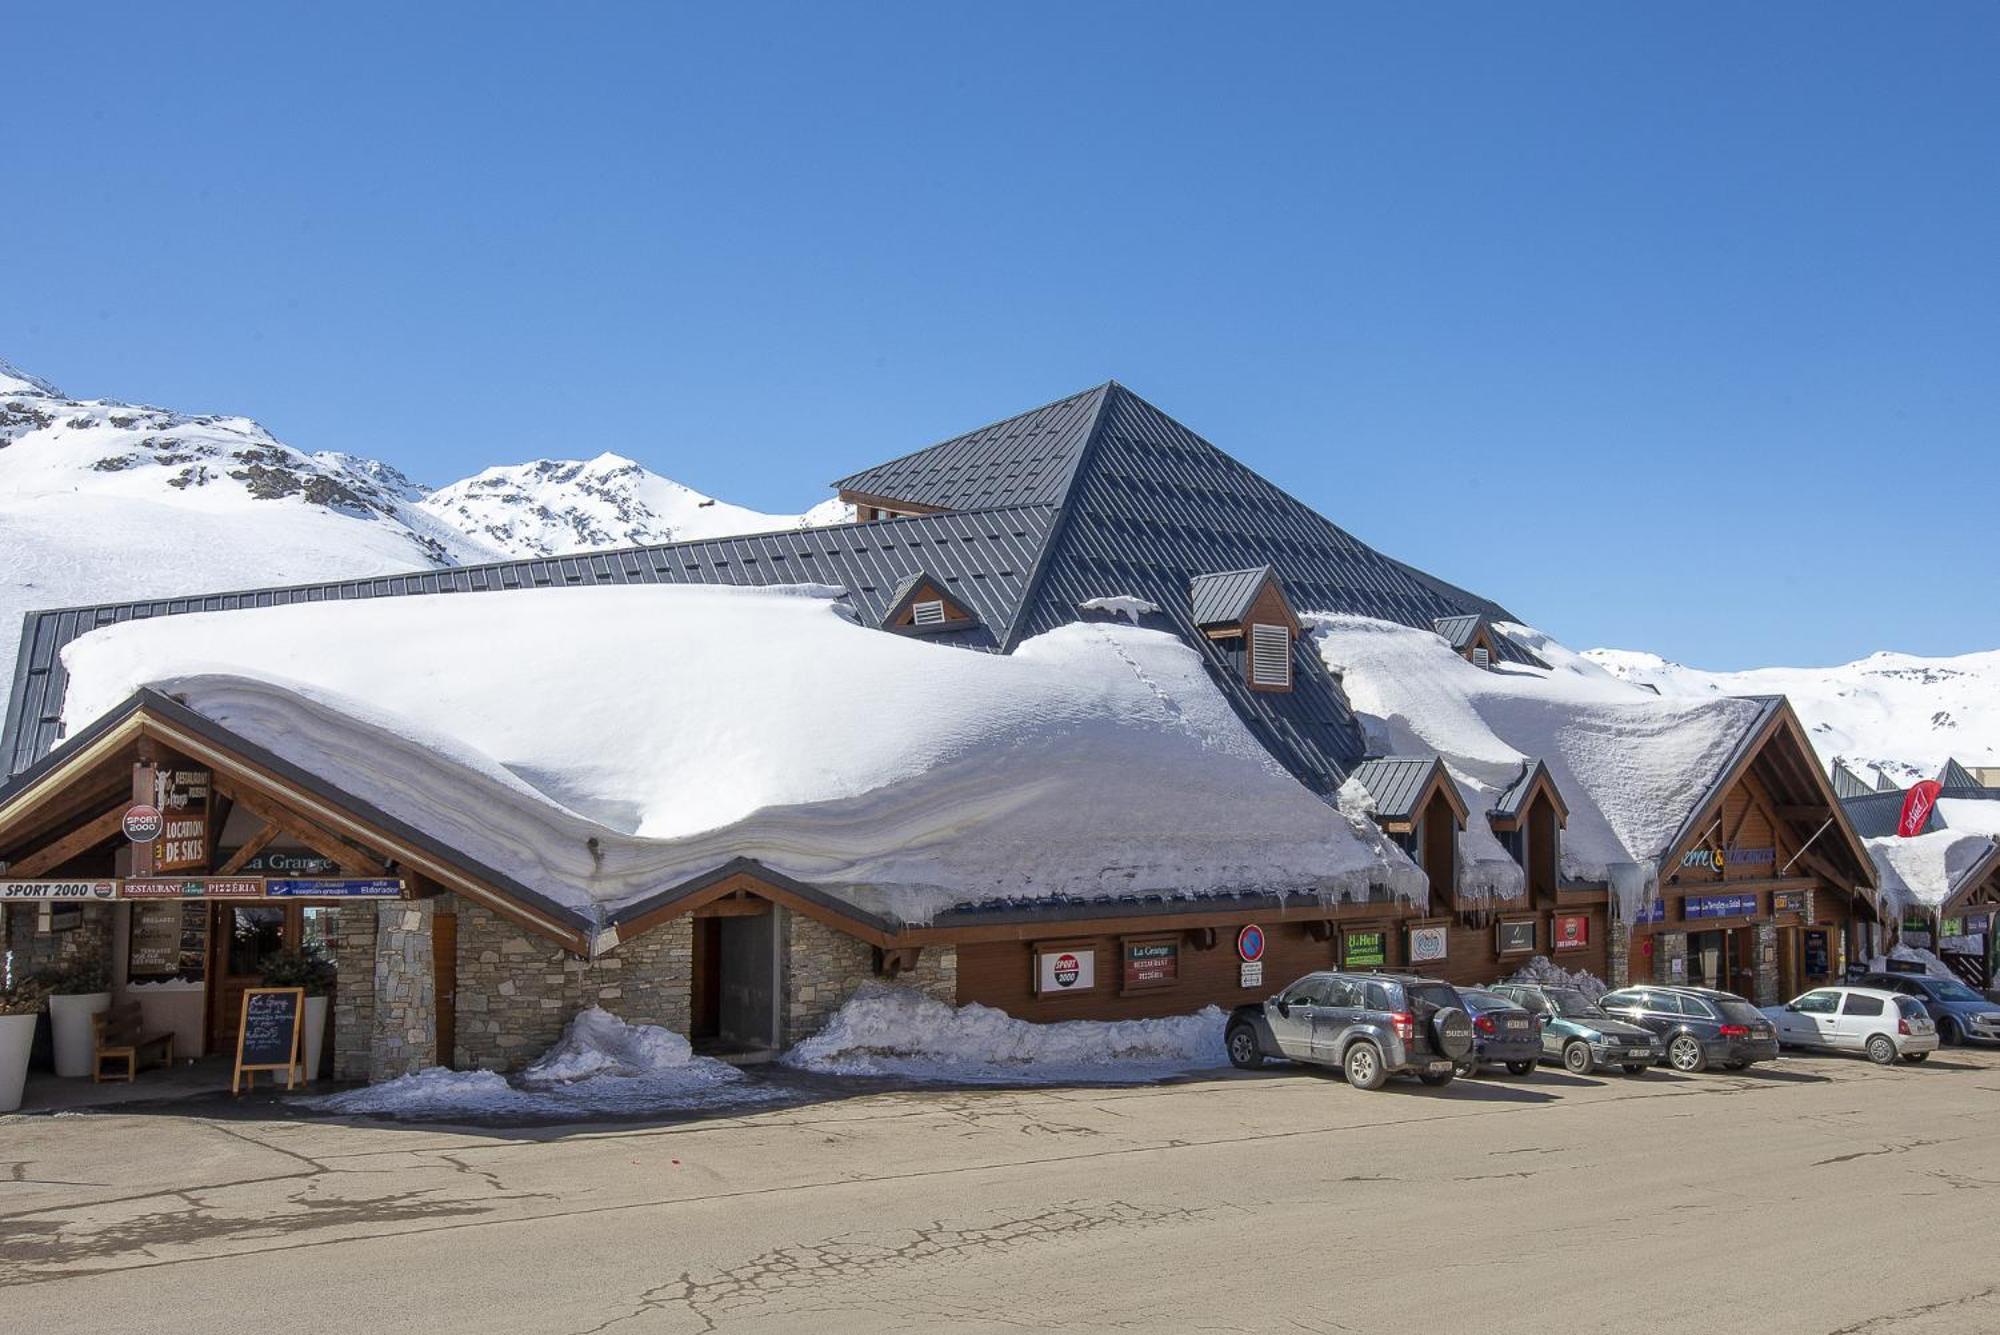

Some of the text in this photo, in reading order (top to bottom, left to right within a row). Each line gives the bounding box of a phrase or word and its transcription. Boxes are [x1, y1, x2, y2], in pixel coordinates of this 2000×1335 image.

[127, 816, 158, 824] SPORT
[130, 824, 156, 832] 2000
[166, 821, 204, 839] LOCATION
[166, 842, 180, 863] DE
[182, 840, 203, 861] SKIS
[6, 884, 89, 897] SPORT 2000
[124, 884, 182, 893] RESTAURANT
[208, 881, 256, 893] PIZZÉRIA
[1133, 946, 1169, 956] La Grange
[1055, 960, 1077, 969] SPORT
[1133, 960, 1169, 969] RESTAURANT
[1059, 973, 1076, 982] 2000
